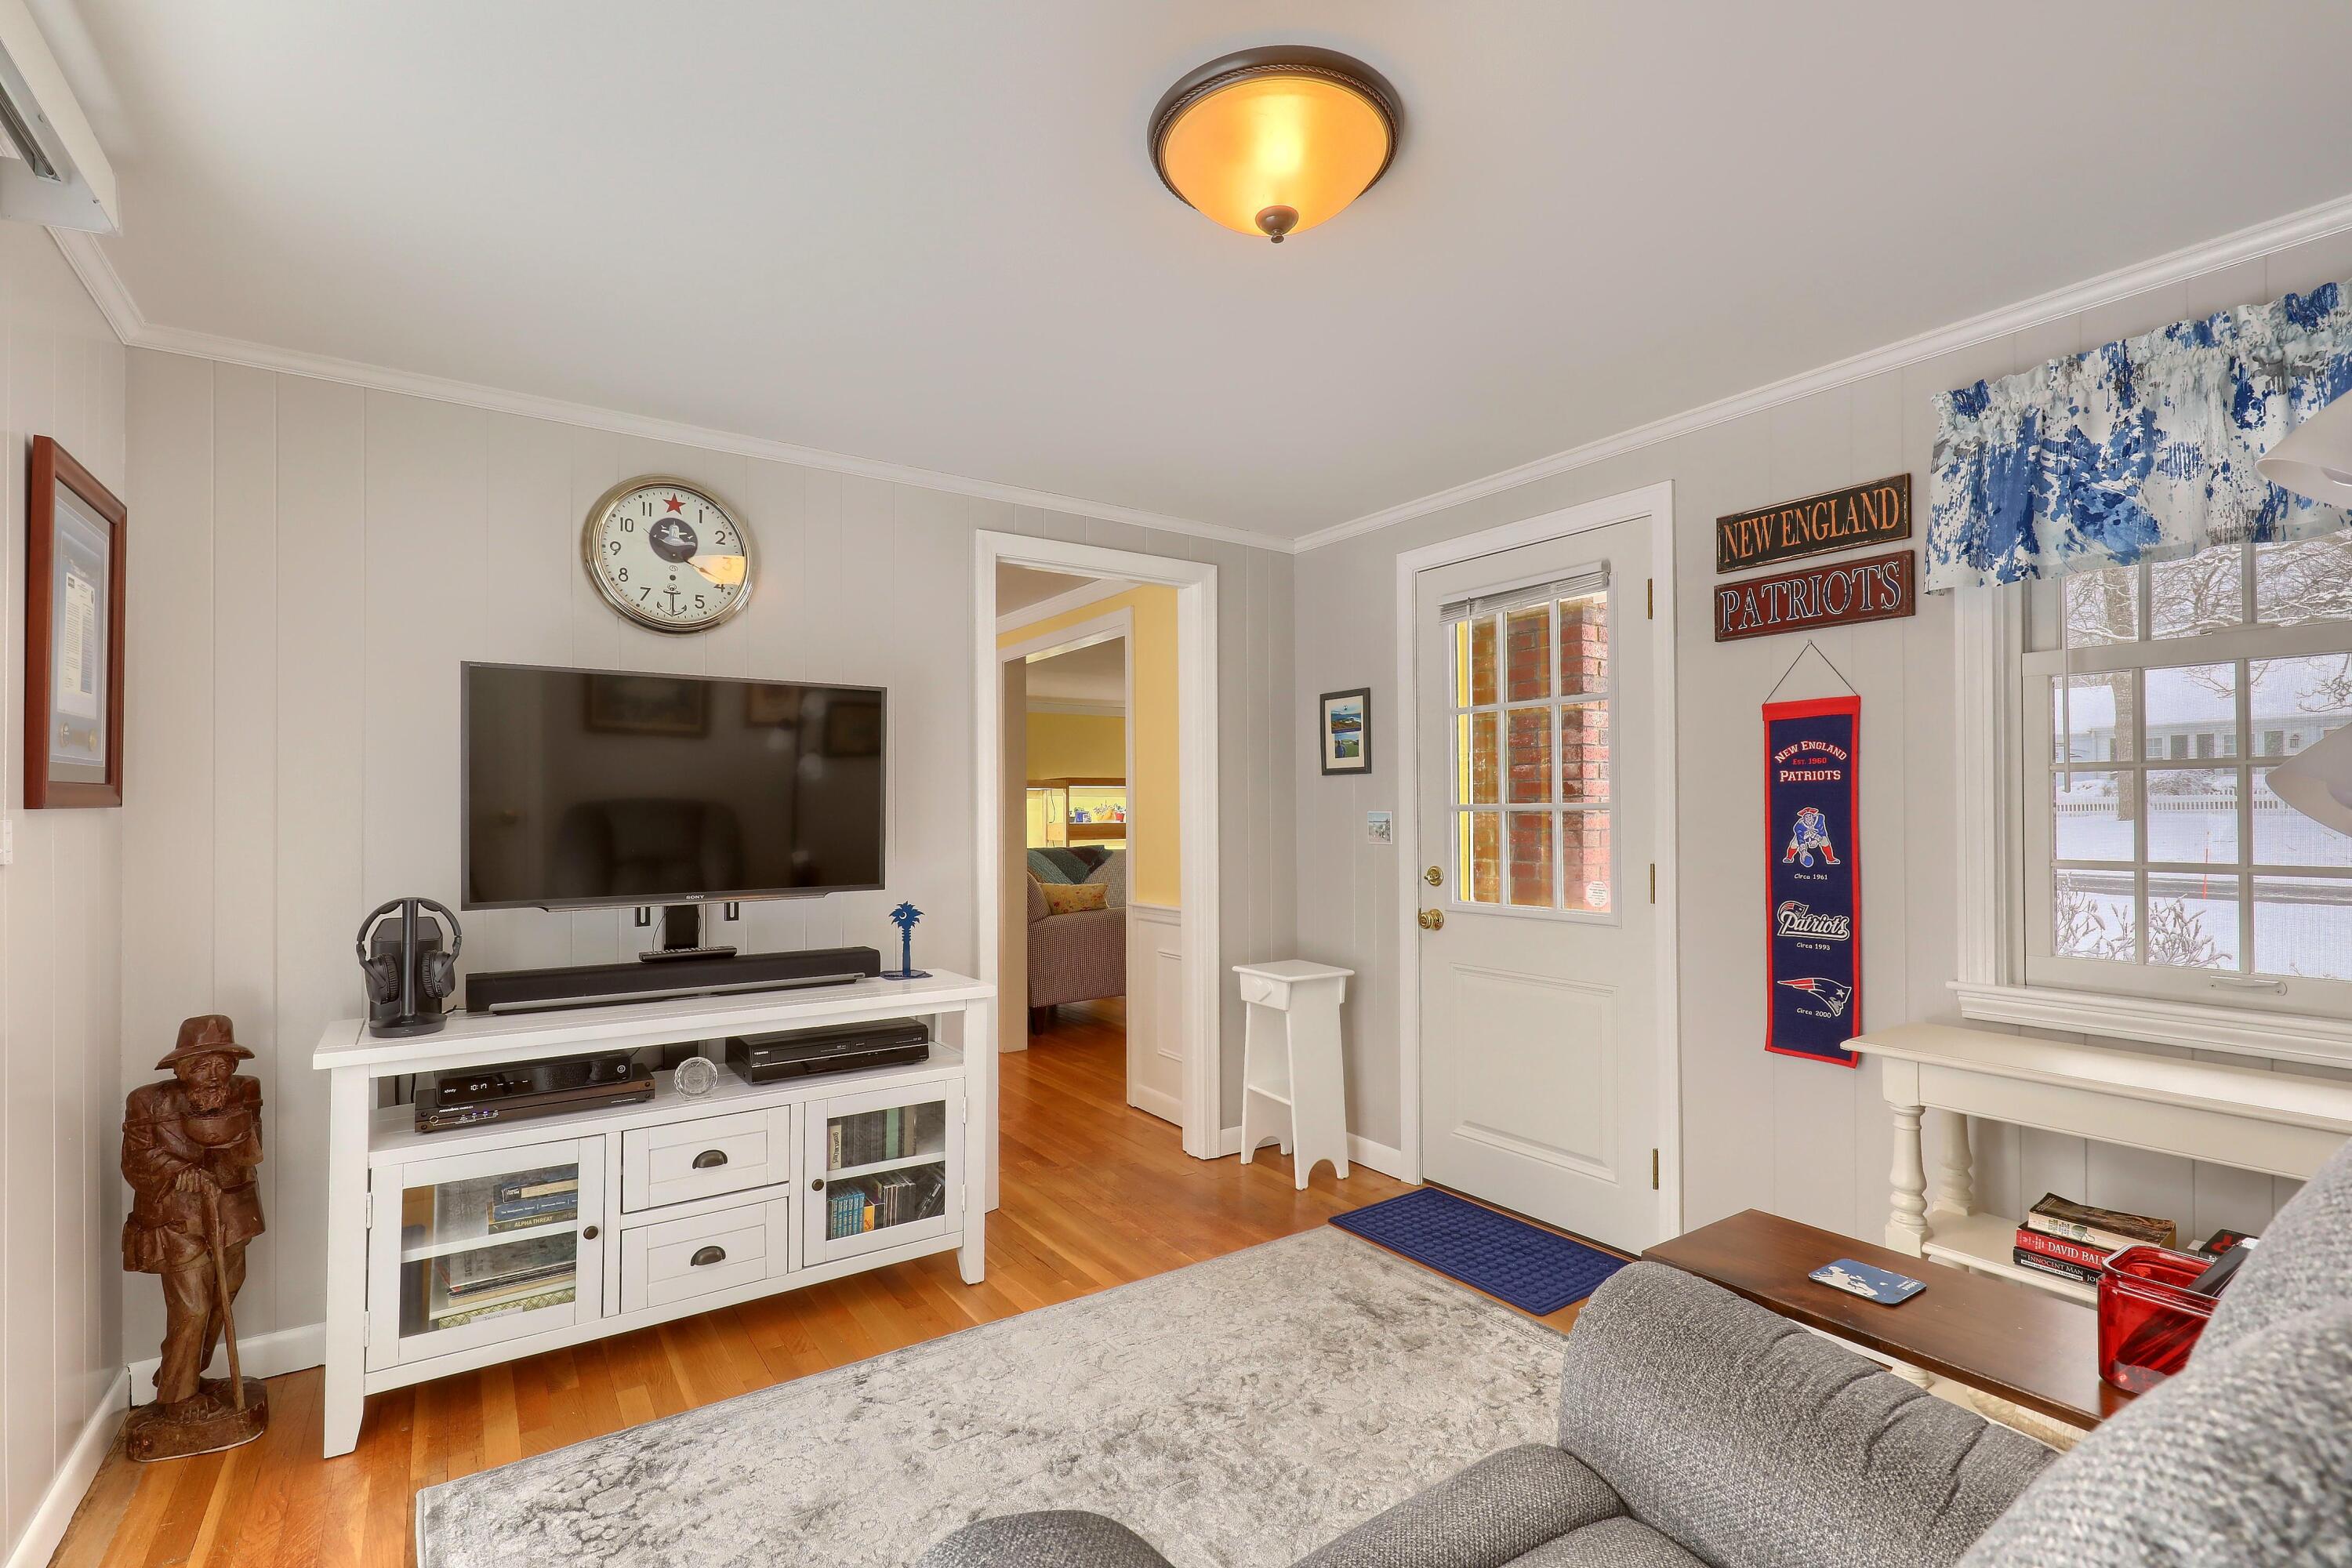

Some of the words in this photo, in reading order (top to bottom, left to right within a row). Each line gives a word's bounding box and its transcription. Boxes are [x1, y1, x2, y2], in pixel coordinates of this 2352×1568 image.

[642, 502, 652, 517] 11
[699, 510, 702, 524] 1
[620, 517, 634, 533] 10
[1724, 514, 1775, 562] NEW
[1780, 487, 1899, 547] ENGLAND
[714, 530, 726, 545] 2
[610, 541, 621, 556] 9
[619, 568, 629, 582] 8
[640, 586, 651, 601] 7
[1720, 561, 1901, 633] PATRIOTS
[695, 594, 705, 609] 5
[1774, 744, 1798, 764] NEW
[1800, 740, 1847, 761] ENGLAND
[1780, 770, 1841, 782] PATRIOTS
[1778, 911, 1849, 940] Patriots
[533, 1216, 553, 1225] THREAT
[2048, 1241, 2079, 1258] DAVID
[2027, 1254, 2064, 1269] INNOCENT
[2066, 1265, 2084, 1276] MAN
